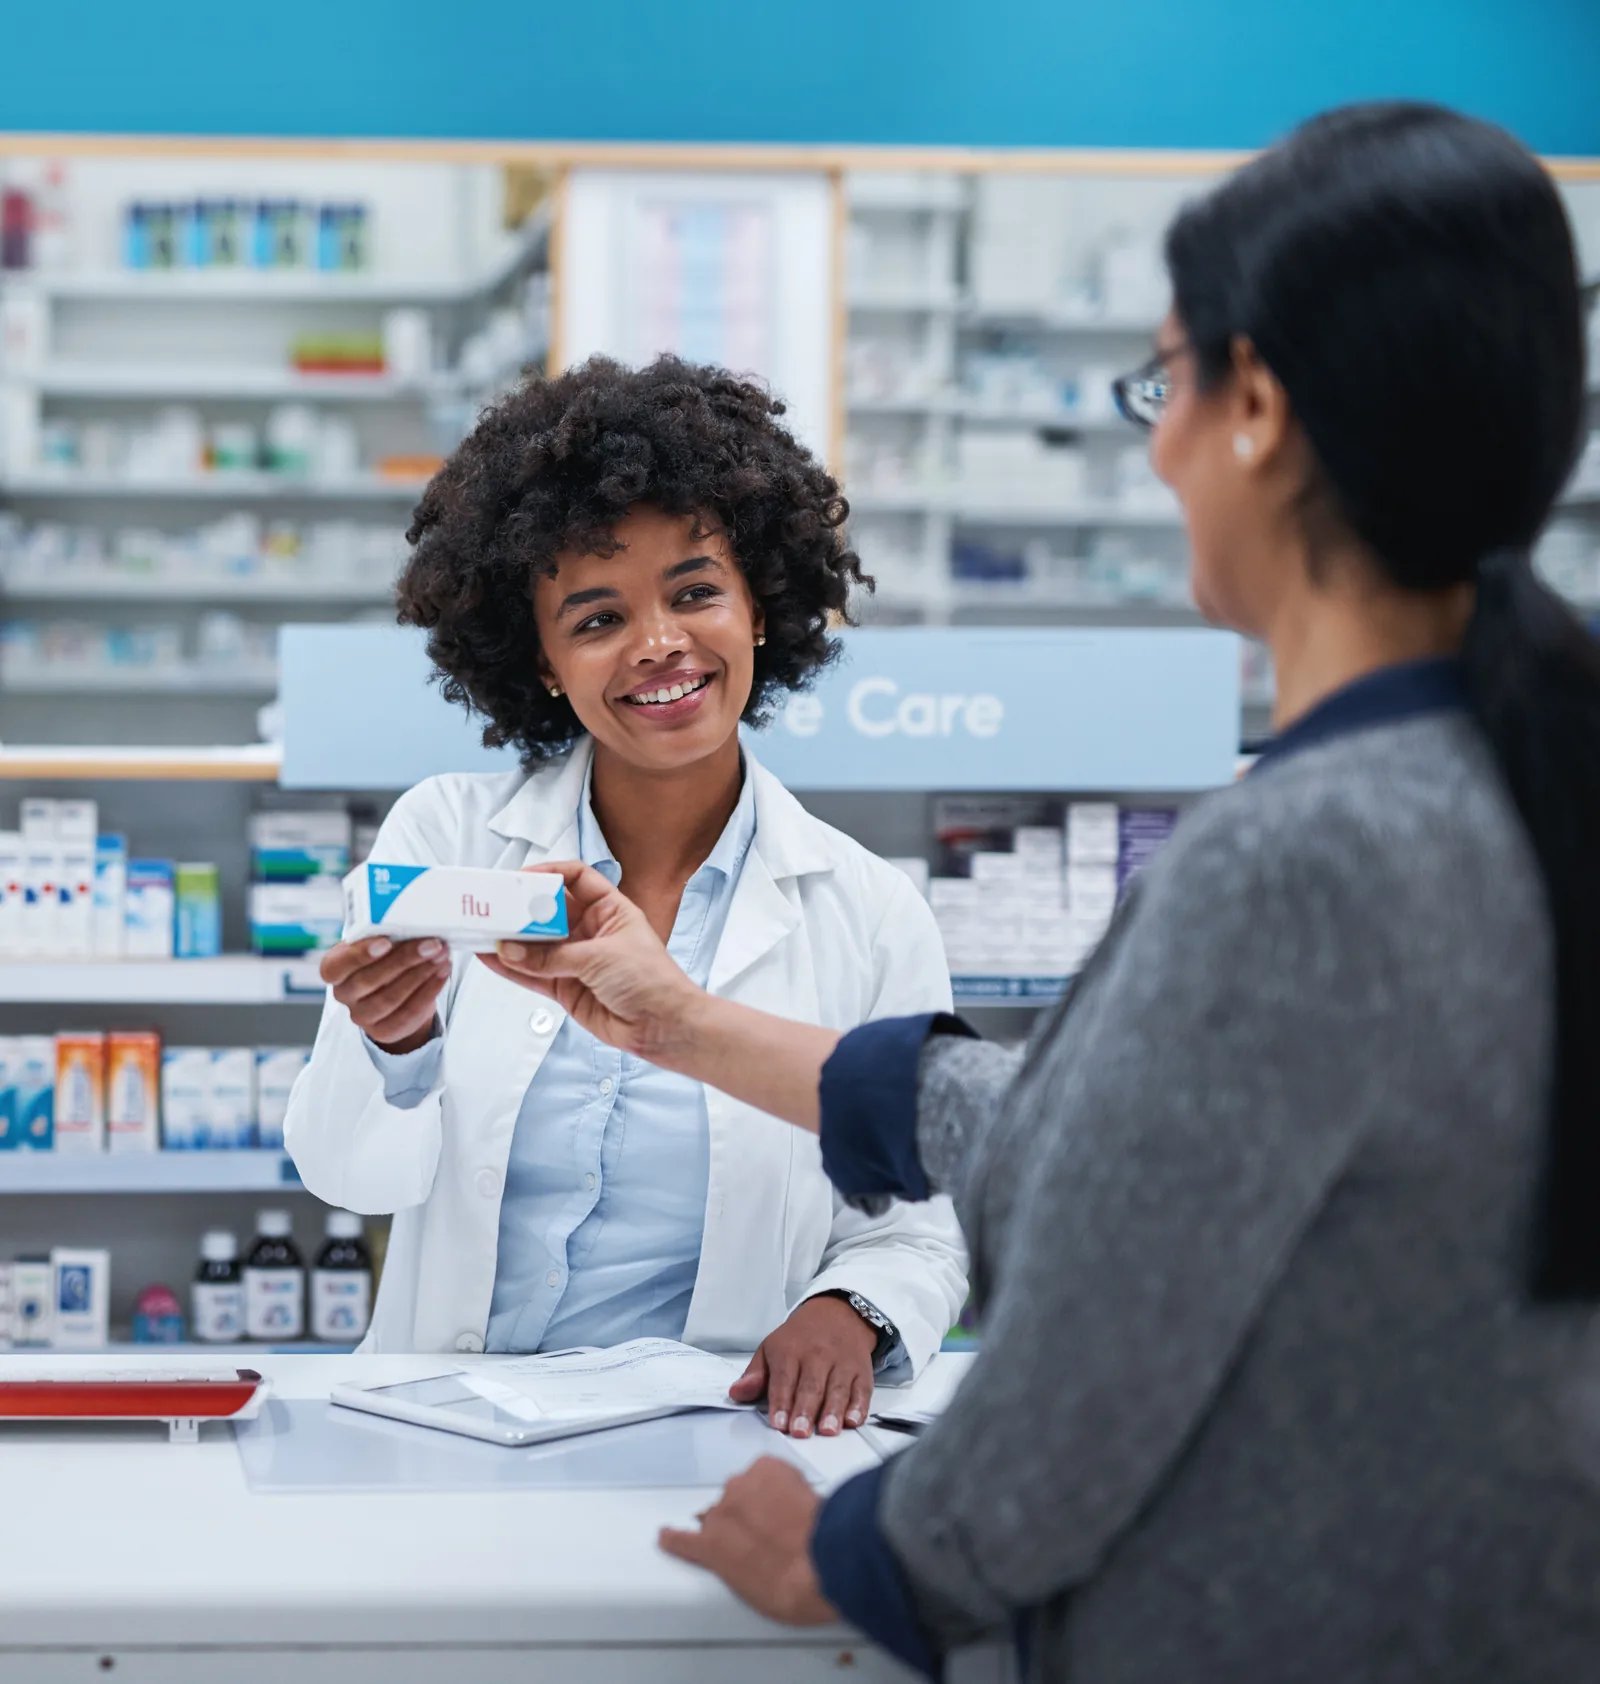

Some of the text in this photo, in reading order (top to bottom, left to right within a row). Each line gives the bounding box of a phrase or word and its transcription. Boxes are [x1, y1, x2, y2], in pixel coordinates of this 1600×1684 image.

[781, 677, 1003, 738] e Care
[462, 894, 489, 917] flu
